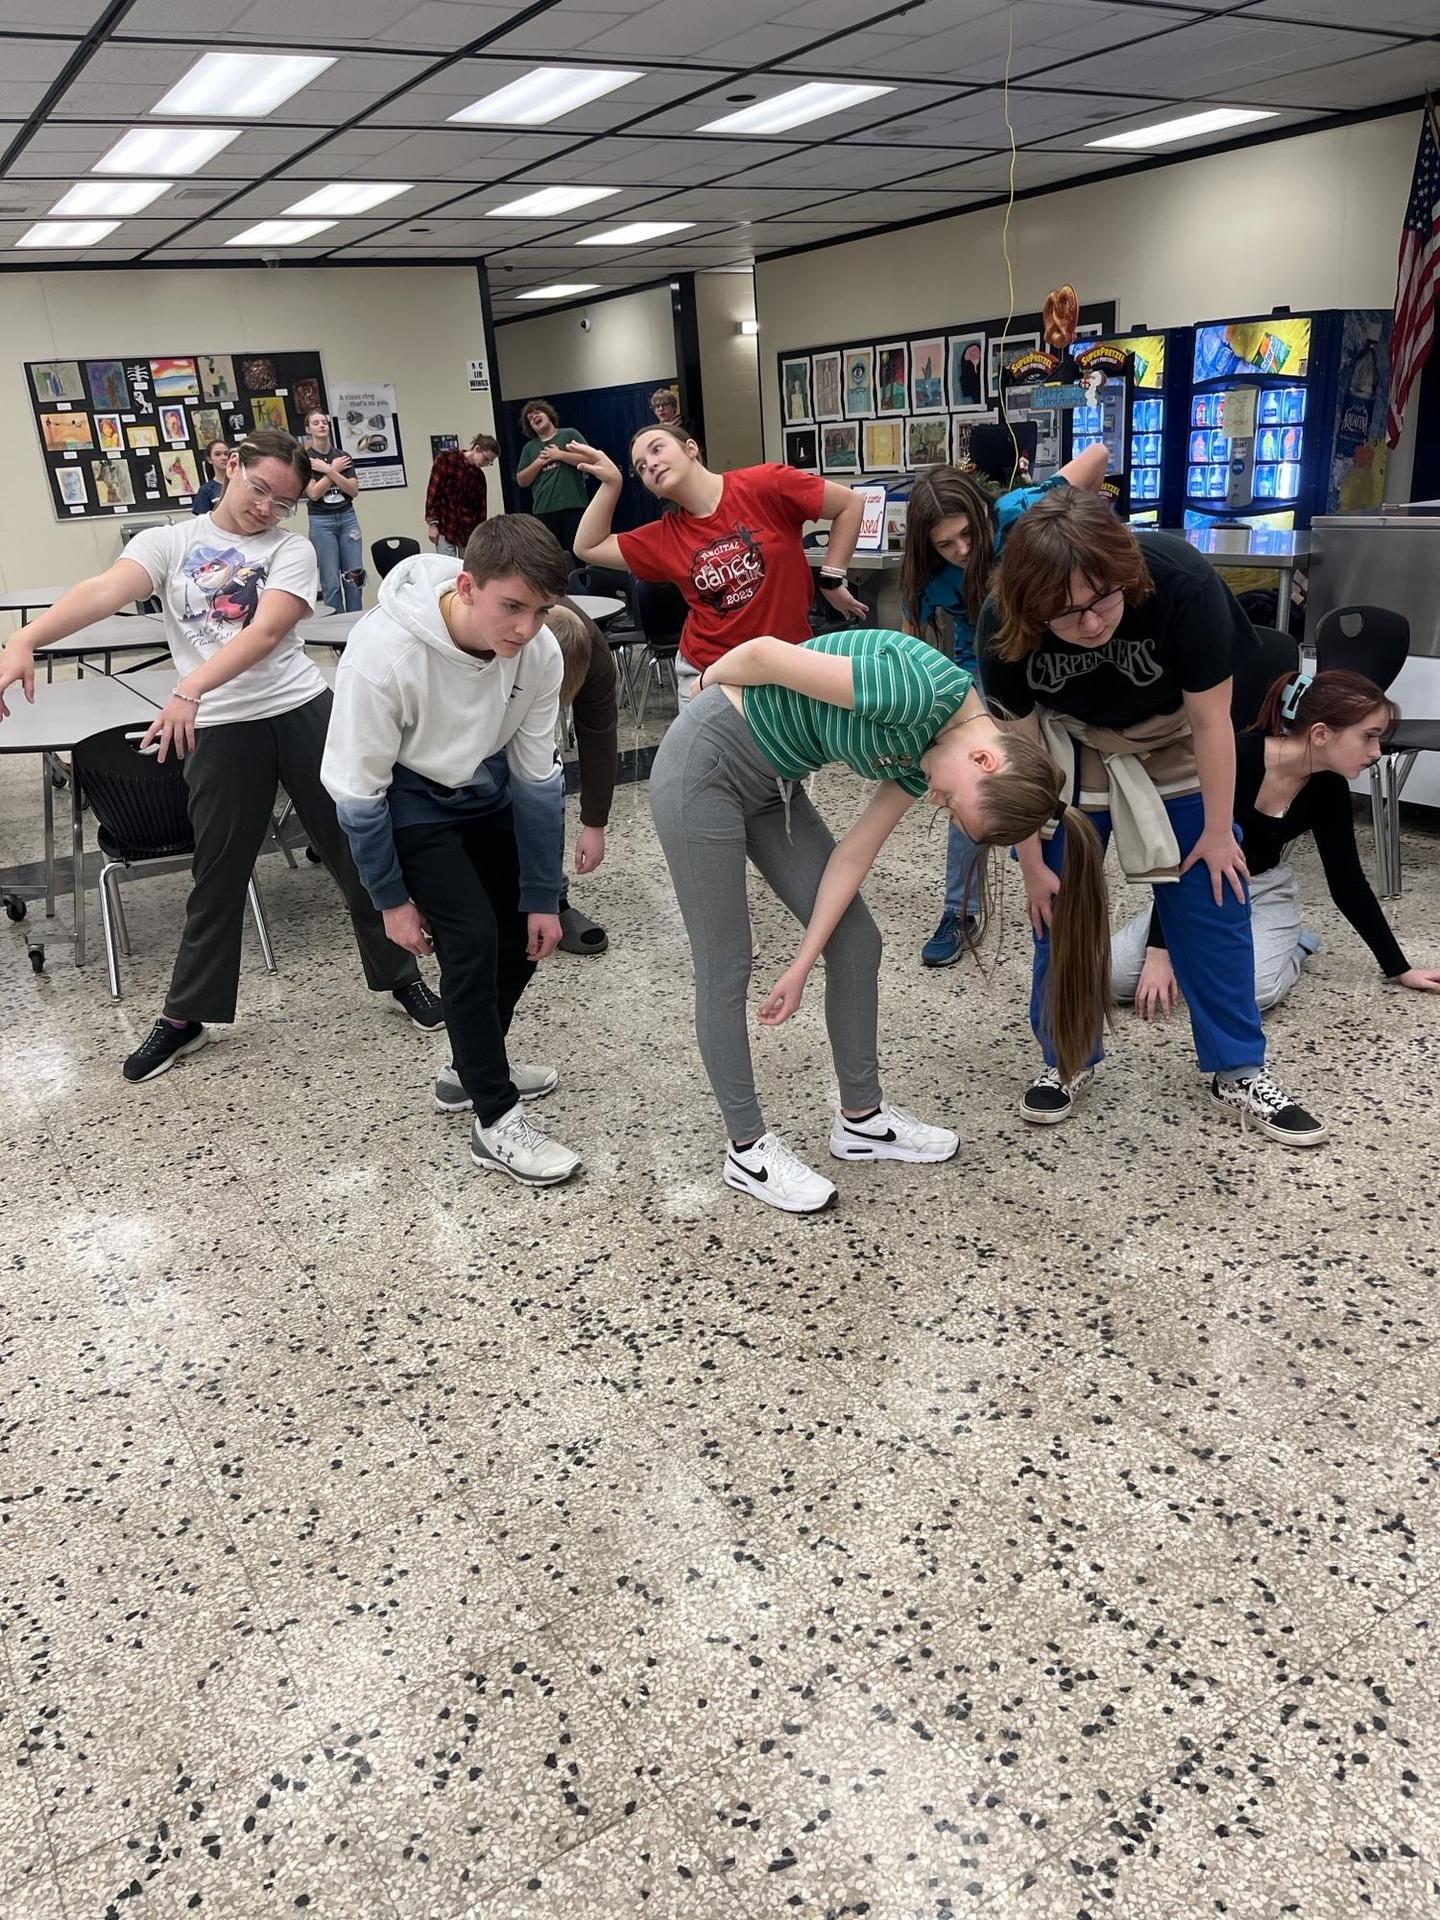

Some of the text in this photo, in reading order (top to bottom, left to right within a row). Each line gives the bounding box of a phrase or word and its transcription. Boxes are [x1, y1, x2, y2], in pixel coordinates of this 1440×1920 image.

[1081, 346, 1126, 366] SUPERPRETZEL
[859, 510, 883, 534] osed
[694, 552, 759, 591] dance
[726, 588, 754, 605] 2023
[1026, 638, 1164, 694] CARPENTERS
